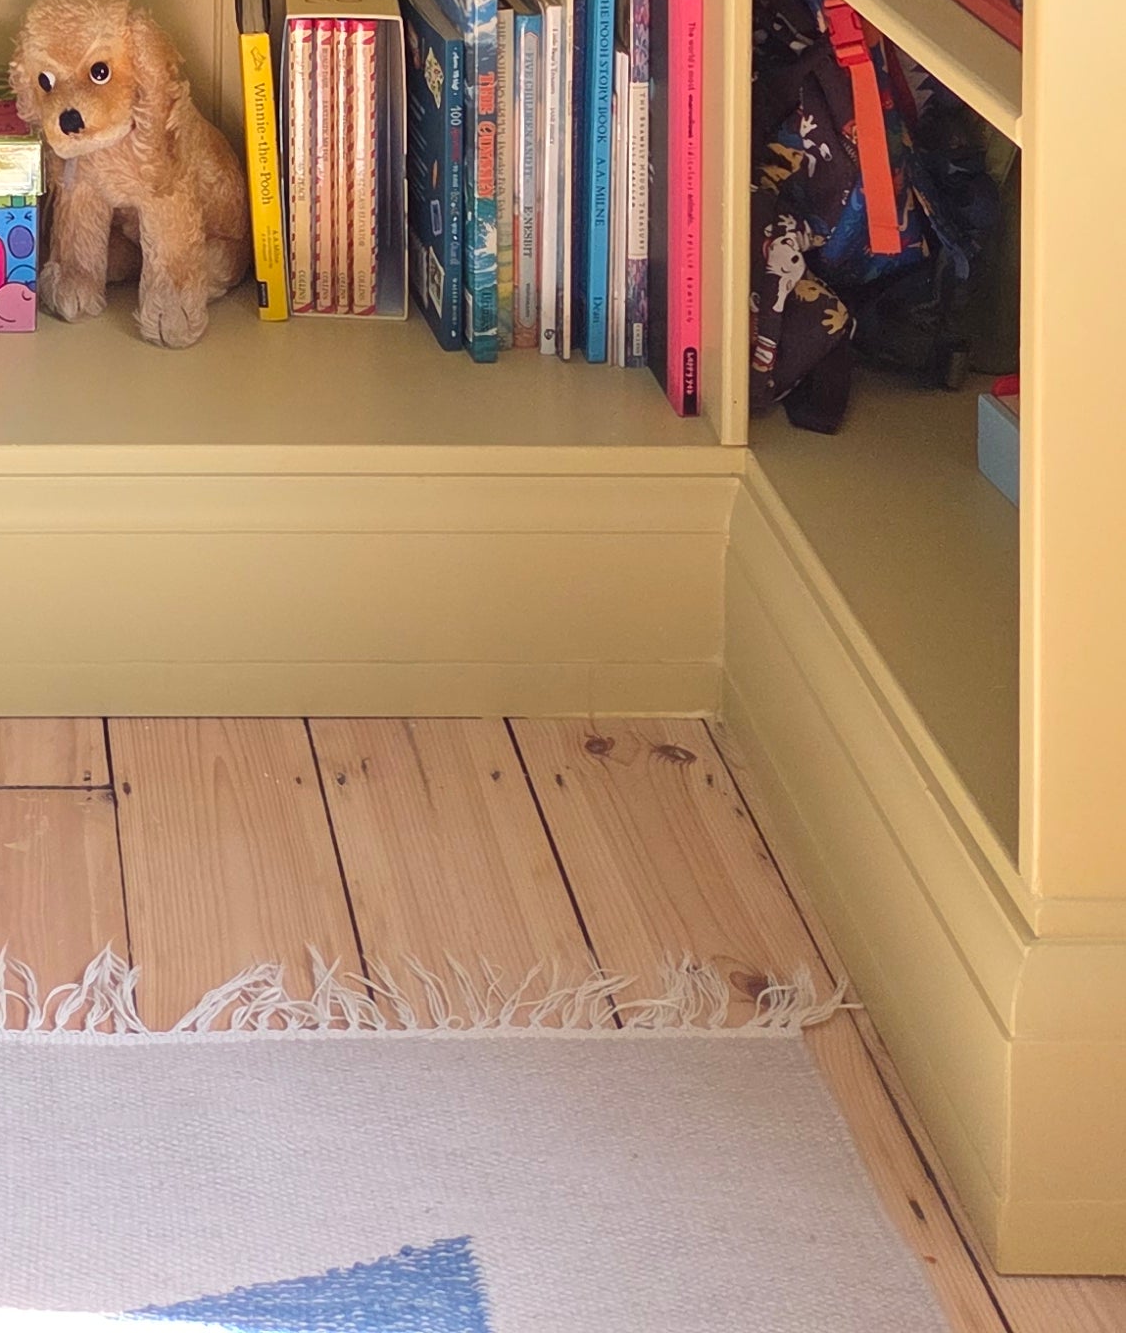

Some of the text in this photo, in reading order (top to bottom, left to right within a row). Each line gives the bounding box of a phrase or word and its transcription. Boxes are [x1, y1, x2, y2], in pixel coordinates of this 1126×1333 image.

[599, 20, 610, 58] POOH
[688, 22, 697, 38] The
[497, 44, 507, 98] BROTHERS
[687, 39, 696, 68] world's
[597, 59, 610, 104] STORY
[688, 70, 696, 91] most
[450, 105, 462, 126] 100
[524, 52, 534, 176] FIVE CHILDREN AND IT
[596, 106, 609, 144] BOOK
[253, 82, 274, 206] Winnie-the-Pooh
[476, 71, 497, 199] THE ODYSSEY
[638, 92, 647, 251] THE BRAMBLY HEDGE TREASURY
[594, 185, 605, 226] MILNE
[358, 210, 366, 247] ELEVATOR
[298, 270, 306, 301] COLLINS
[322, 271, 330, 300] COLLINS
[358, 270, 367, 302] COLLINS
[591, 296, 604, 324] Dean
[683, 351, 695, 395] happy yak
